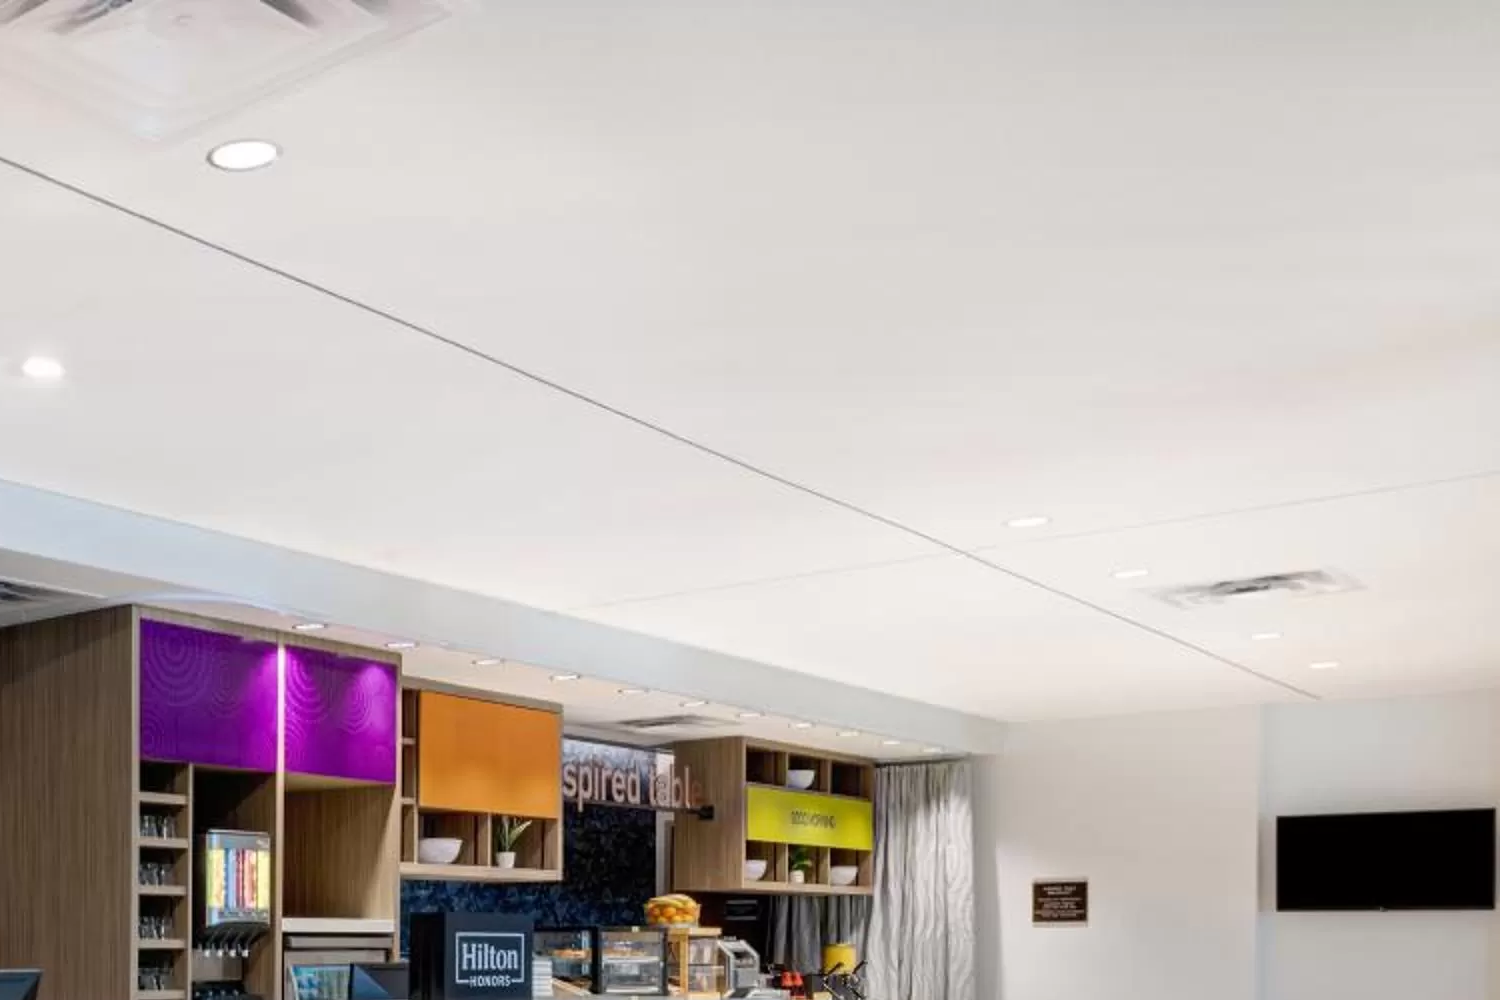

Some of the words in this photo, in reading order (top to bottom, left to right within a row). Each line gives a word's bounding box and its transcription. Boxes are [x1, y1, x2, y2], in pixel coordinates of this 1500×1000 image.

[563, 762, 640, 812] spired
[462, 943, 518, 970] Hilton
[469, 975, 511, 987] HONORS
